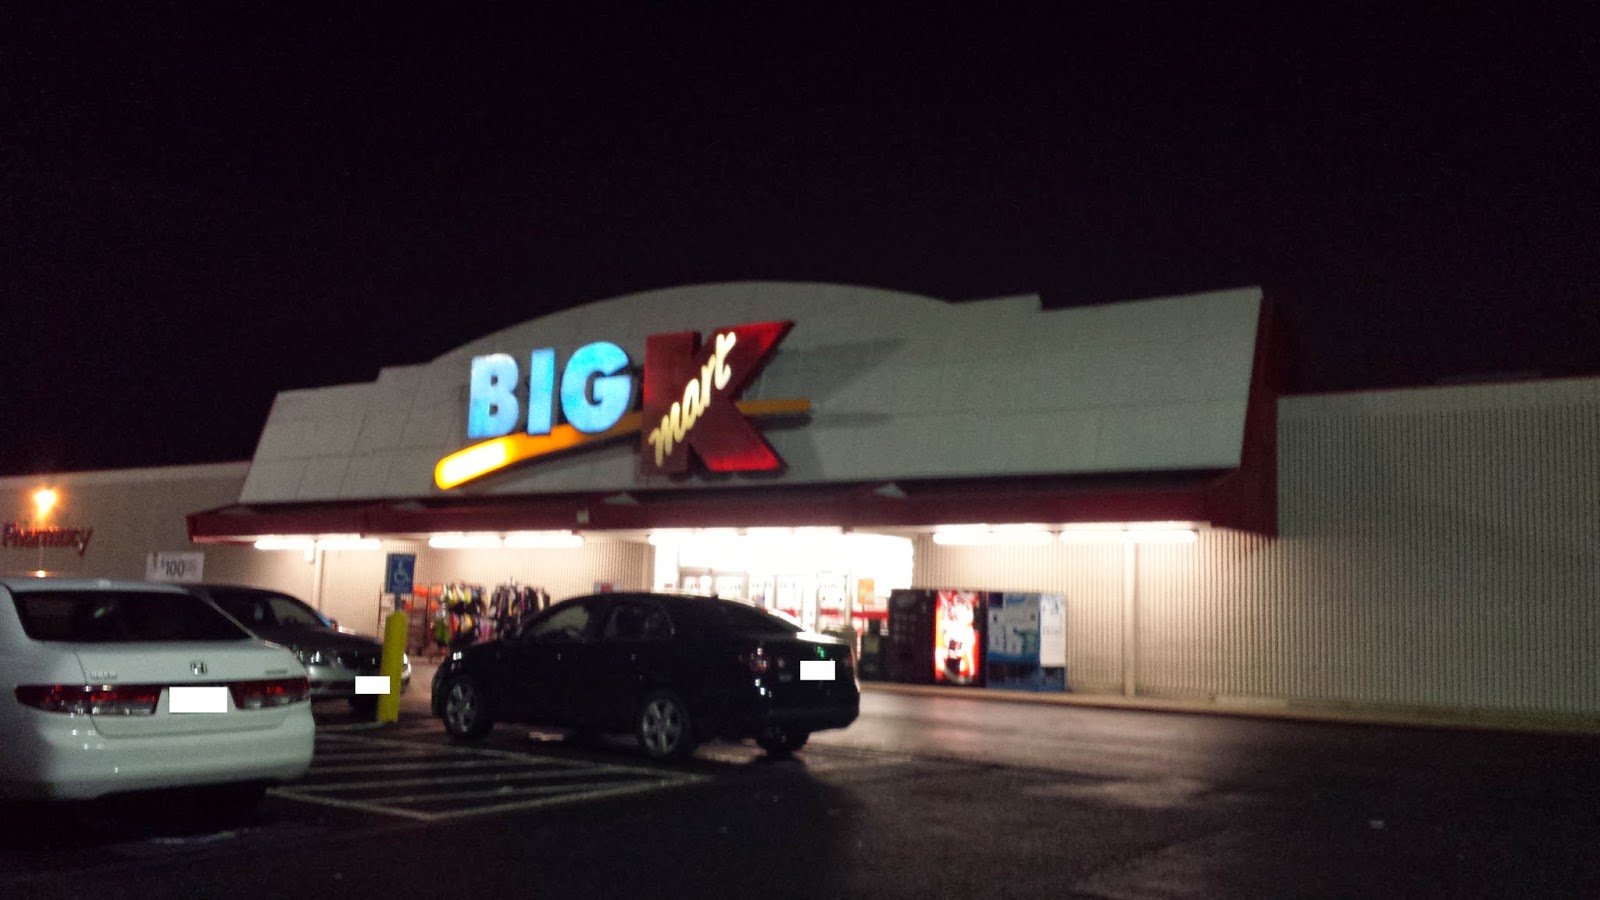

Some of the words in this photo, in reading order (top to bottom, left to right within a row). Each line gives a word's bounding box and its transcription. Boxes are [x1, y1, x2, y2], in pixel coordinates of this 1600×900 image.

[468, 341, 632, 438] BIG
[644, 321, 791, 473] K
[649, 331, 736, 467] mart
